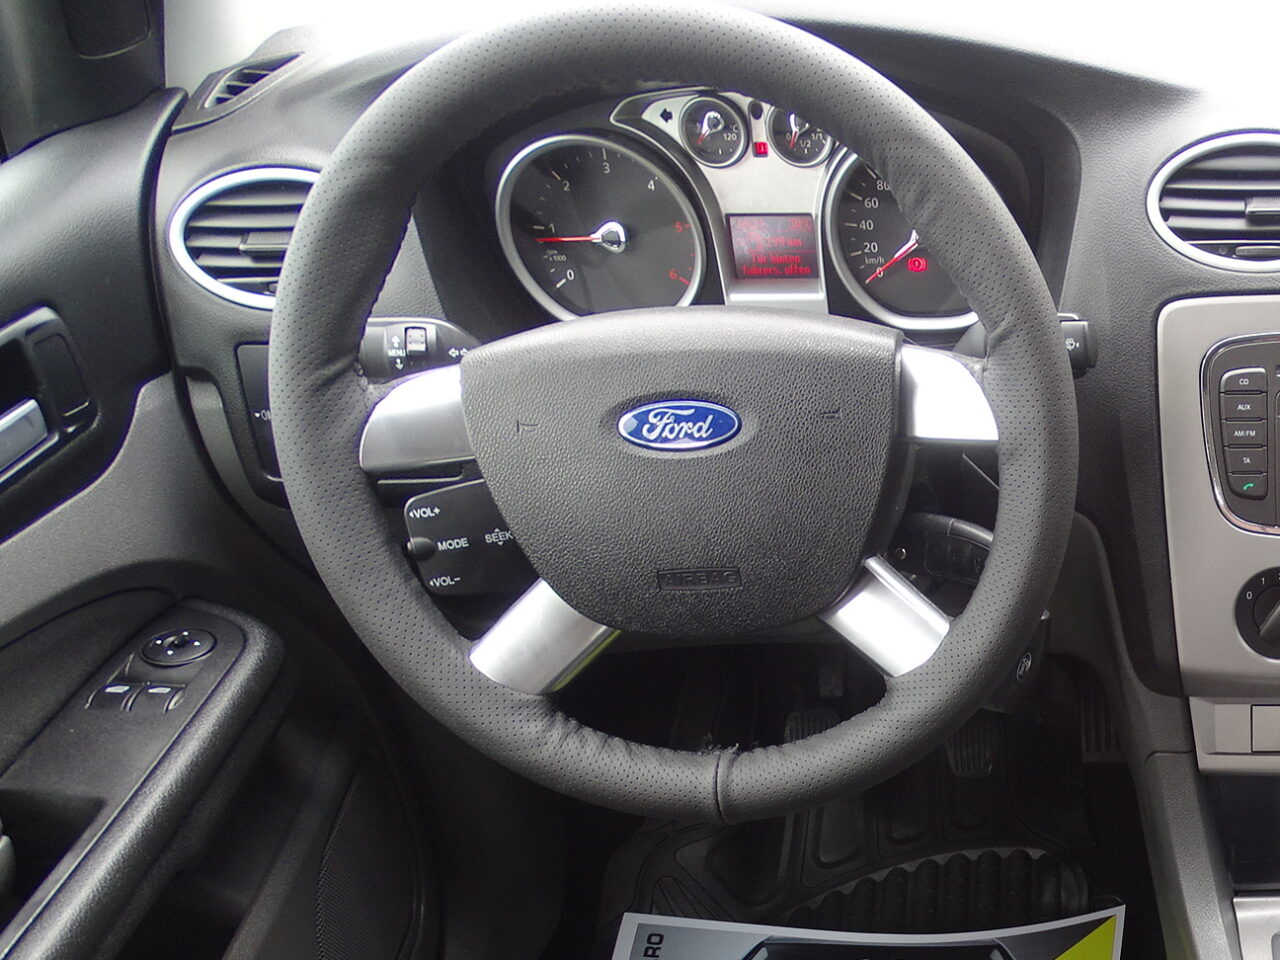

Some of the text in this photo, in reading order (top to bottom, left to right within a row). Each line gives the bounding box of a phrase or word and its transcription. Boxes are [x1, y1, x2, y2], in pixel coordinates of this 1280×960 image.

[723, 133, 737, 141] 120
[603, 163, 610, 173] 3
[563, 181, 570, 192] 2
[648, 180, 655, 191] 4
[876, 180, 890, 190] 80
[864, 197, 879, 208] 60
[549, 223, 556, 233] 1
[675, 222, 683, 233] 5
[859, 220, 874, 231] 40
[864, 242, 878, 253] 20
[865, 256, 885, 265] km/h
[567, 269, 574, 281] 0
[669, 269, 677, 279] 6
[388, 349, 406, 357] MENU
[1237, 403, 1251, 411] AUX
[642, 408, 714, 440] Ford
[484, 530, 514, 543] SEEK
[437, 538, 469, 551] MODE
[1246, 591, 1252, 600] 0
